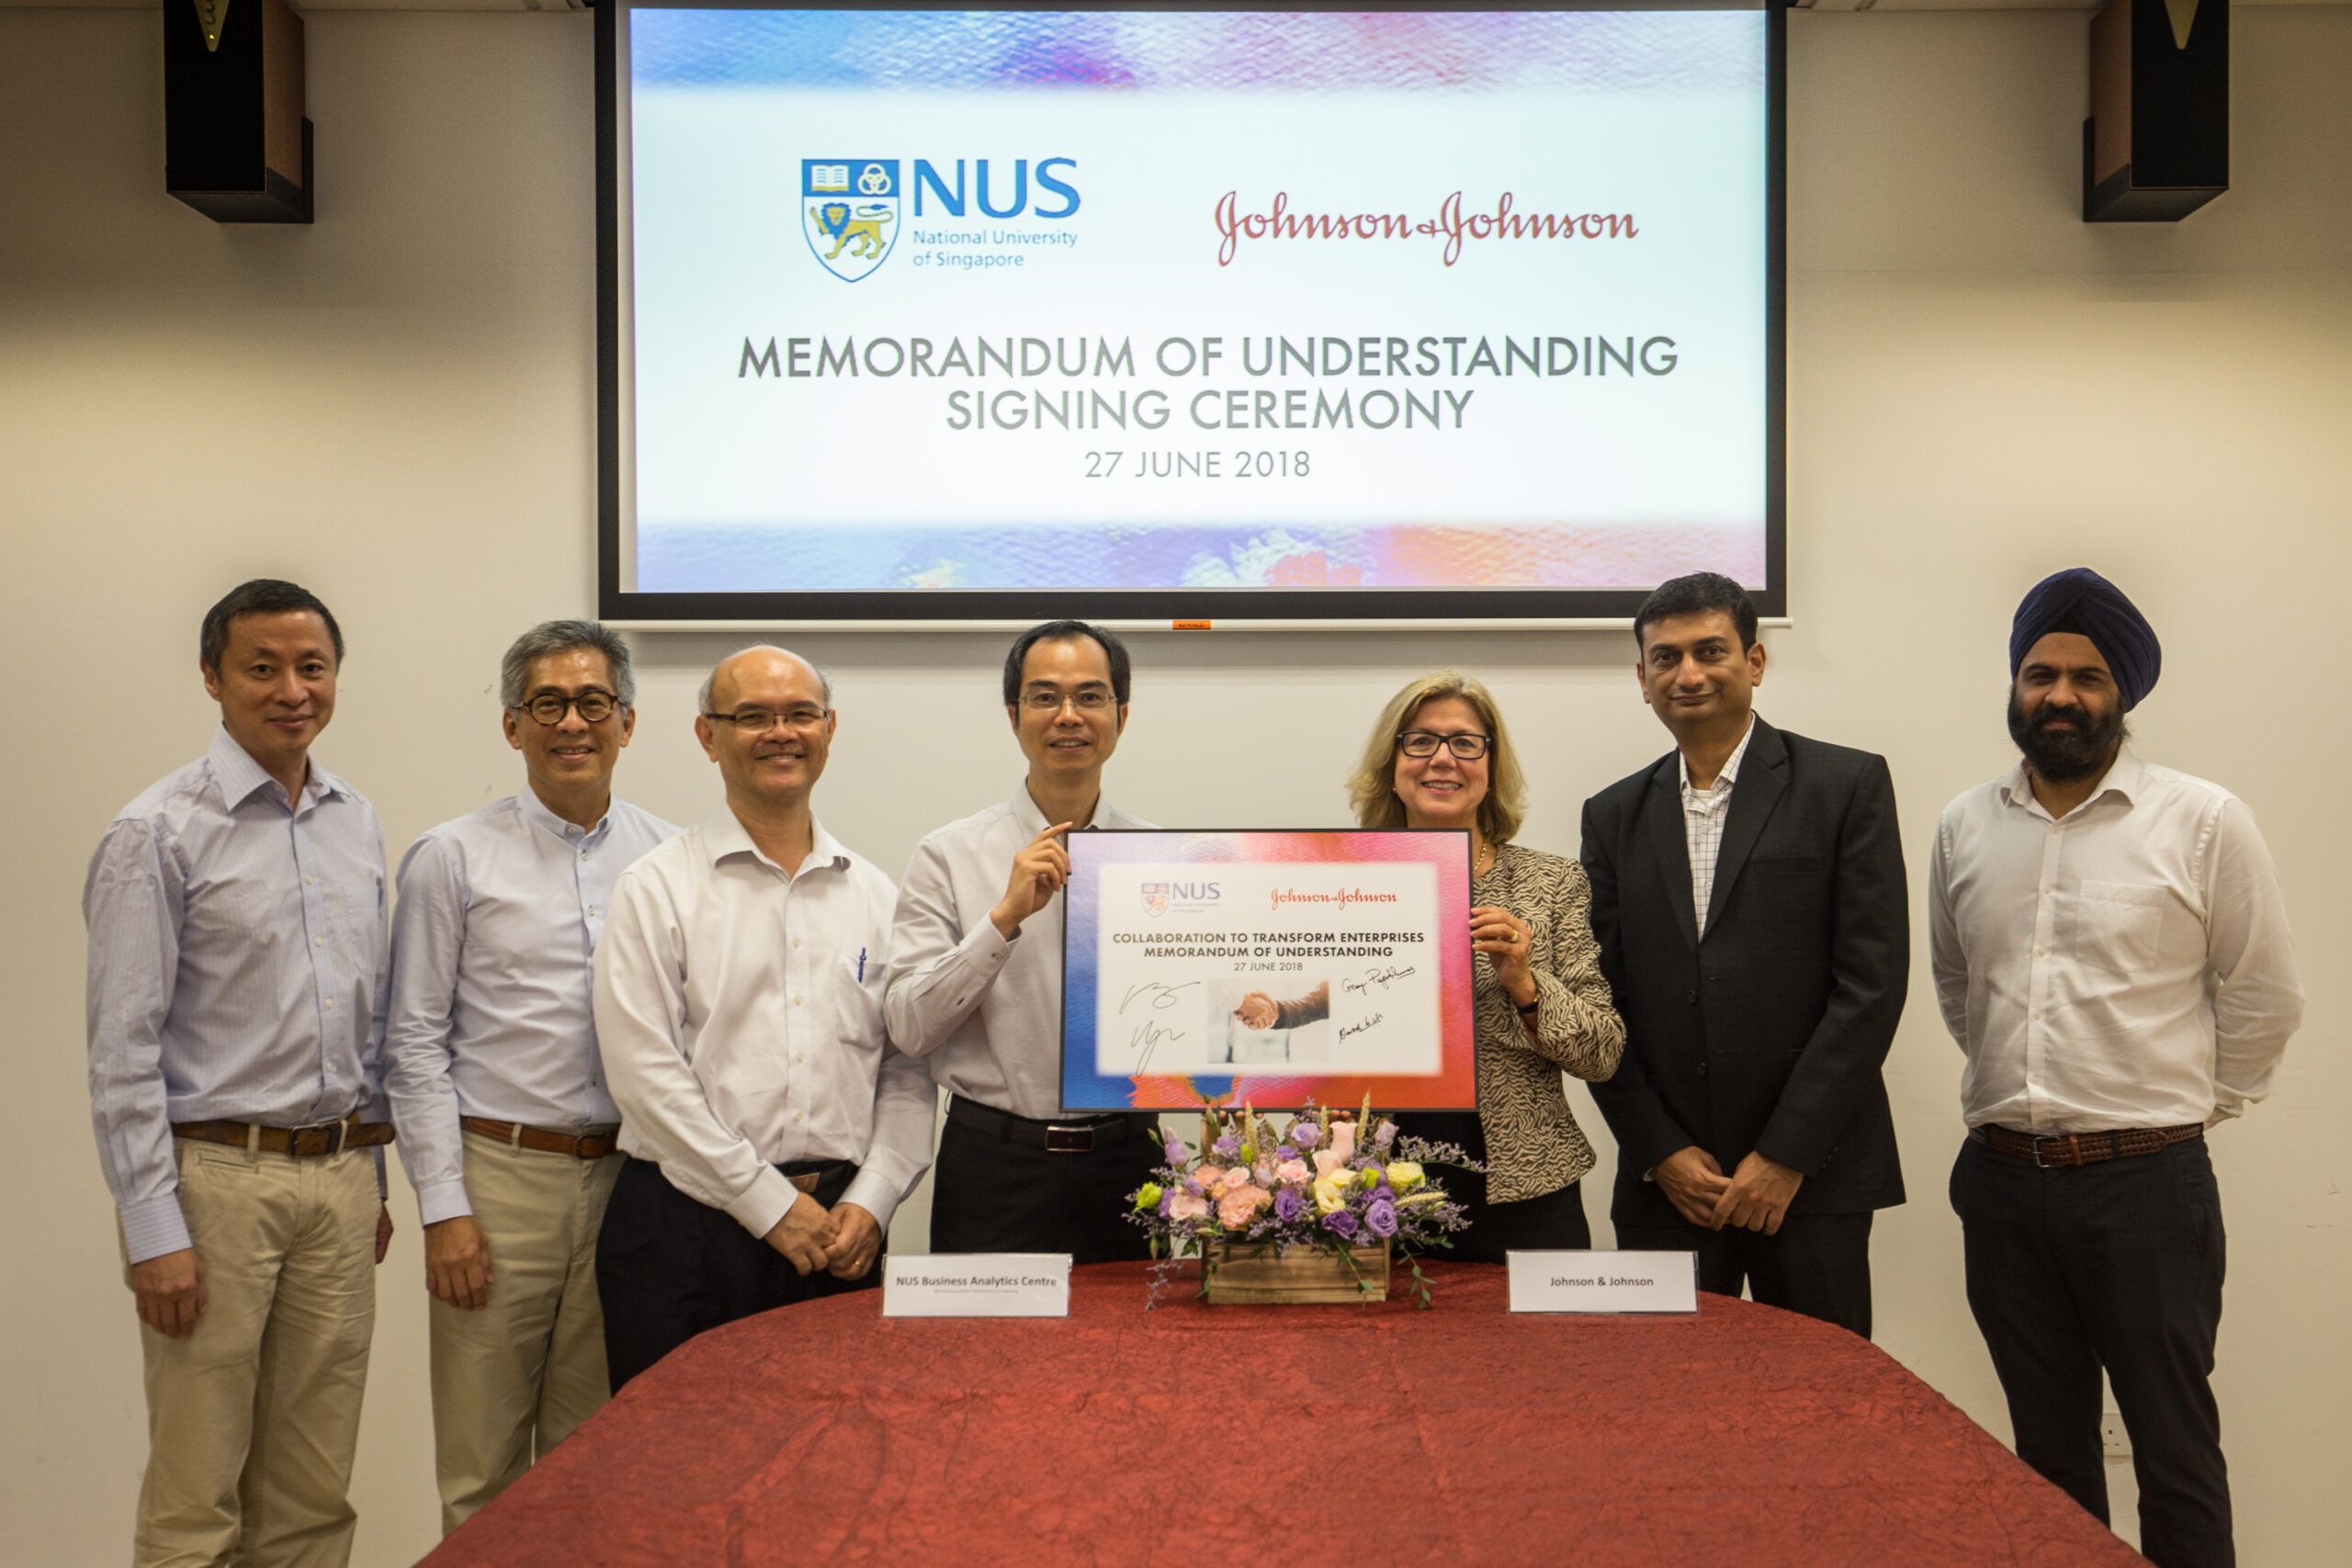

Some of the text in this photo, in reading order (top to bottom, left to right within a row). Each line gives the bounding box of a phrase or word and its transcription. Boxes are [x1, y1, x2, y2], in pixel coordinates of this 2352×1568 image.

[914, 157, 1080, 219] NUS
[912, 229, 1079, 249] National University
[912, 250, 1024, 271] of Singapore
[739, 335, 1678, 378] MEMORANDUM OF UNDERSTANDING
[947, 389, 1475, 430] SIGNING CEREMONY
[1085, 451, 1309, 478] 27 JUNE 2018
[1173, 883, 1220, 899] NUS
[1113, 932, 1425, 944] COLLABORATION TO TRANSFORM ENTERPRISES
[1144, 946, 1394, 957] MEMORANDUM OF UNDERSTANDING
[1234, 962, 1304, 972] 27 JUNE 2018
[896, 1276, 1057, 1288] NUS Business Analytics Centre
[1550, 1276, 1654, 1287] Johnson & Johnson
